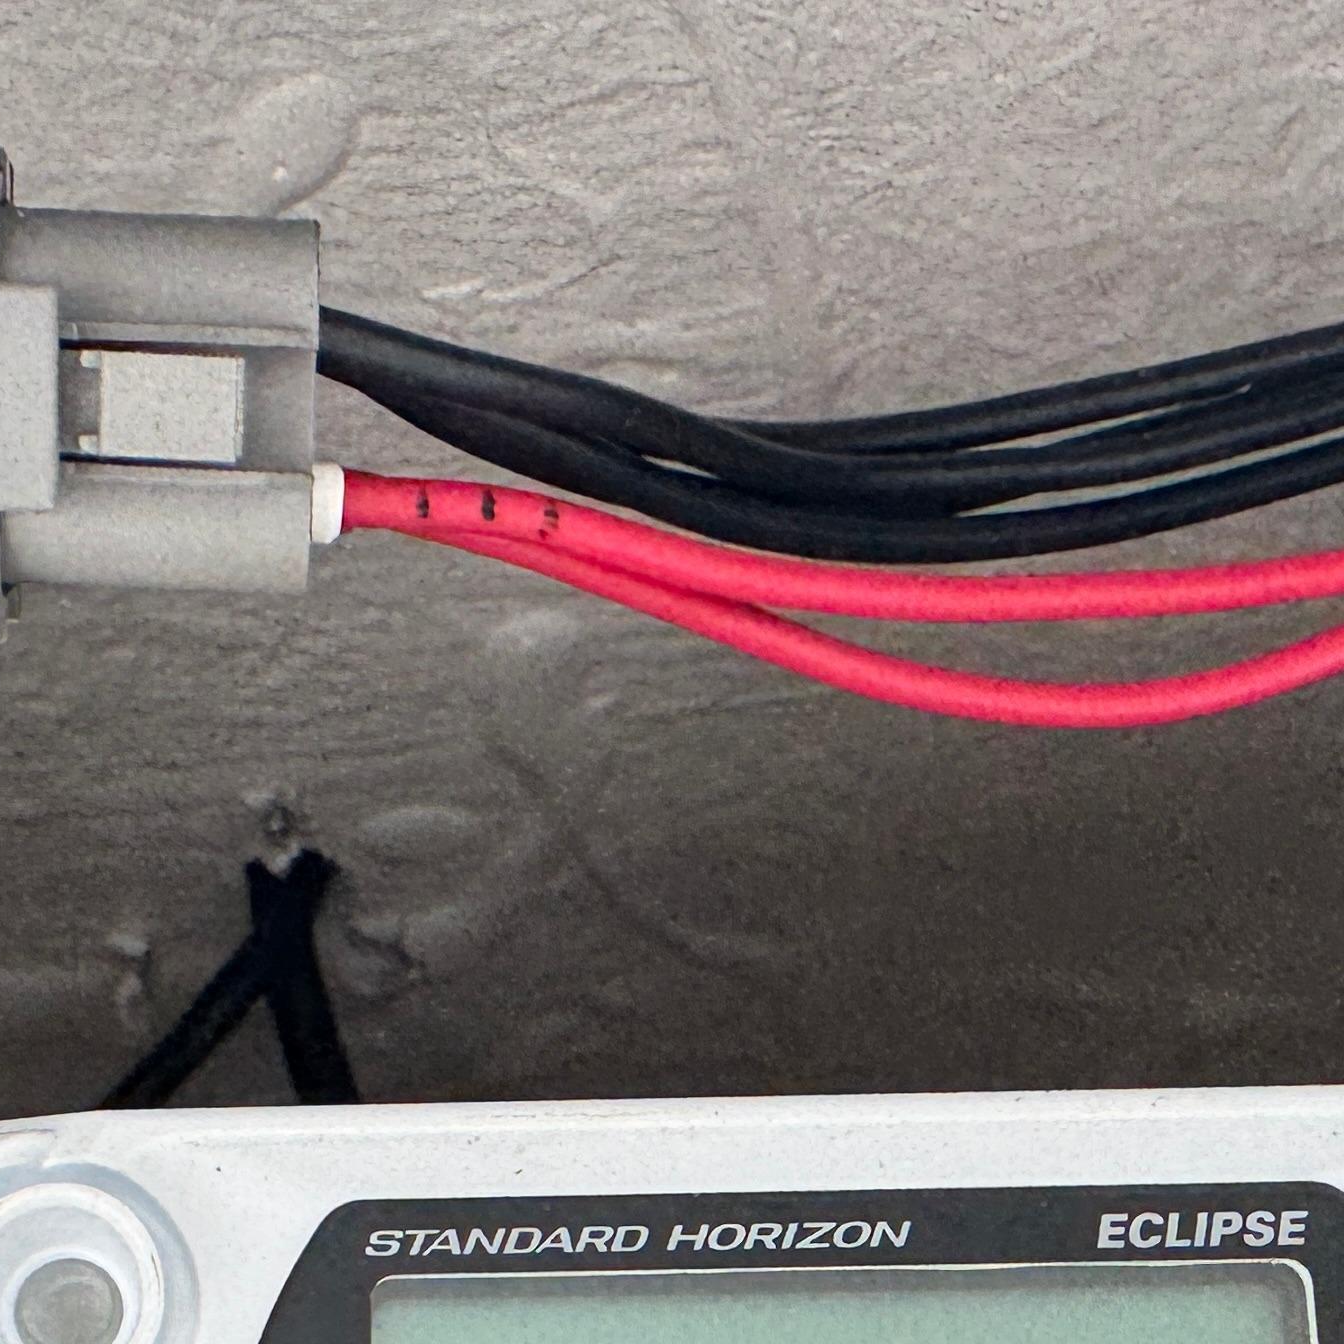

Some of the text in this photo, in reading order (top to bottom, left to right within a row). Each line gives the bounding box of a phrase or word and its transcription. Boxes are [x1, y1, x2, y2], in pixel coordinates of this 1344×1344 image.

[364, 1219, 912, 1258] STANDARD HORIZON
[1095, 1210, 1309, 1250] ECLIPSE
